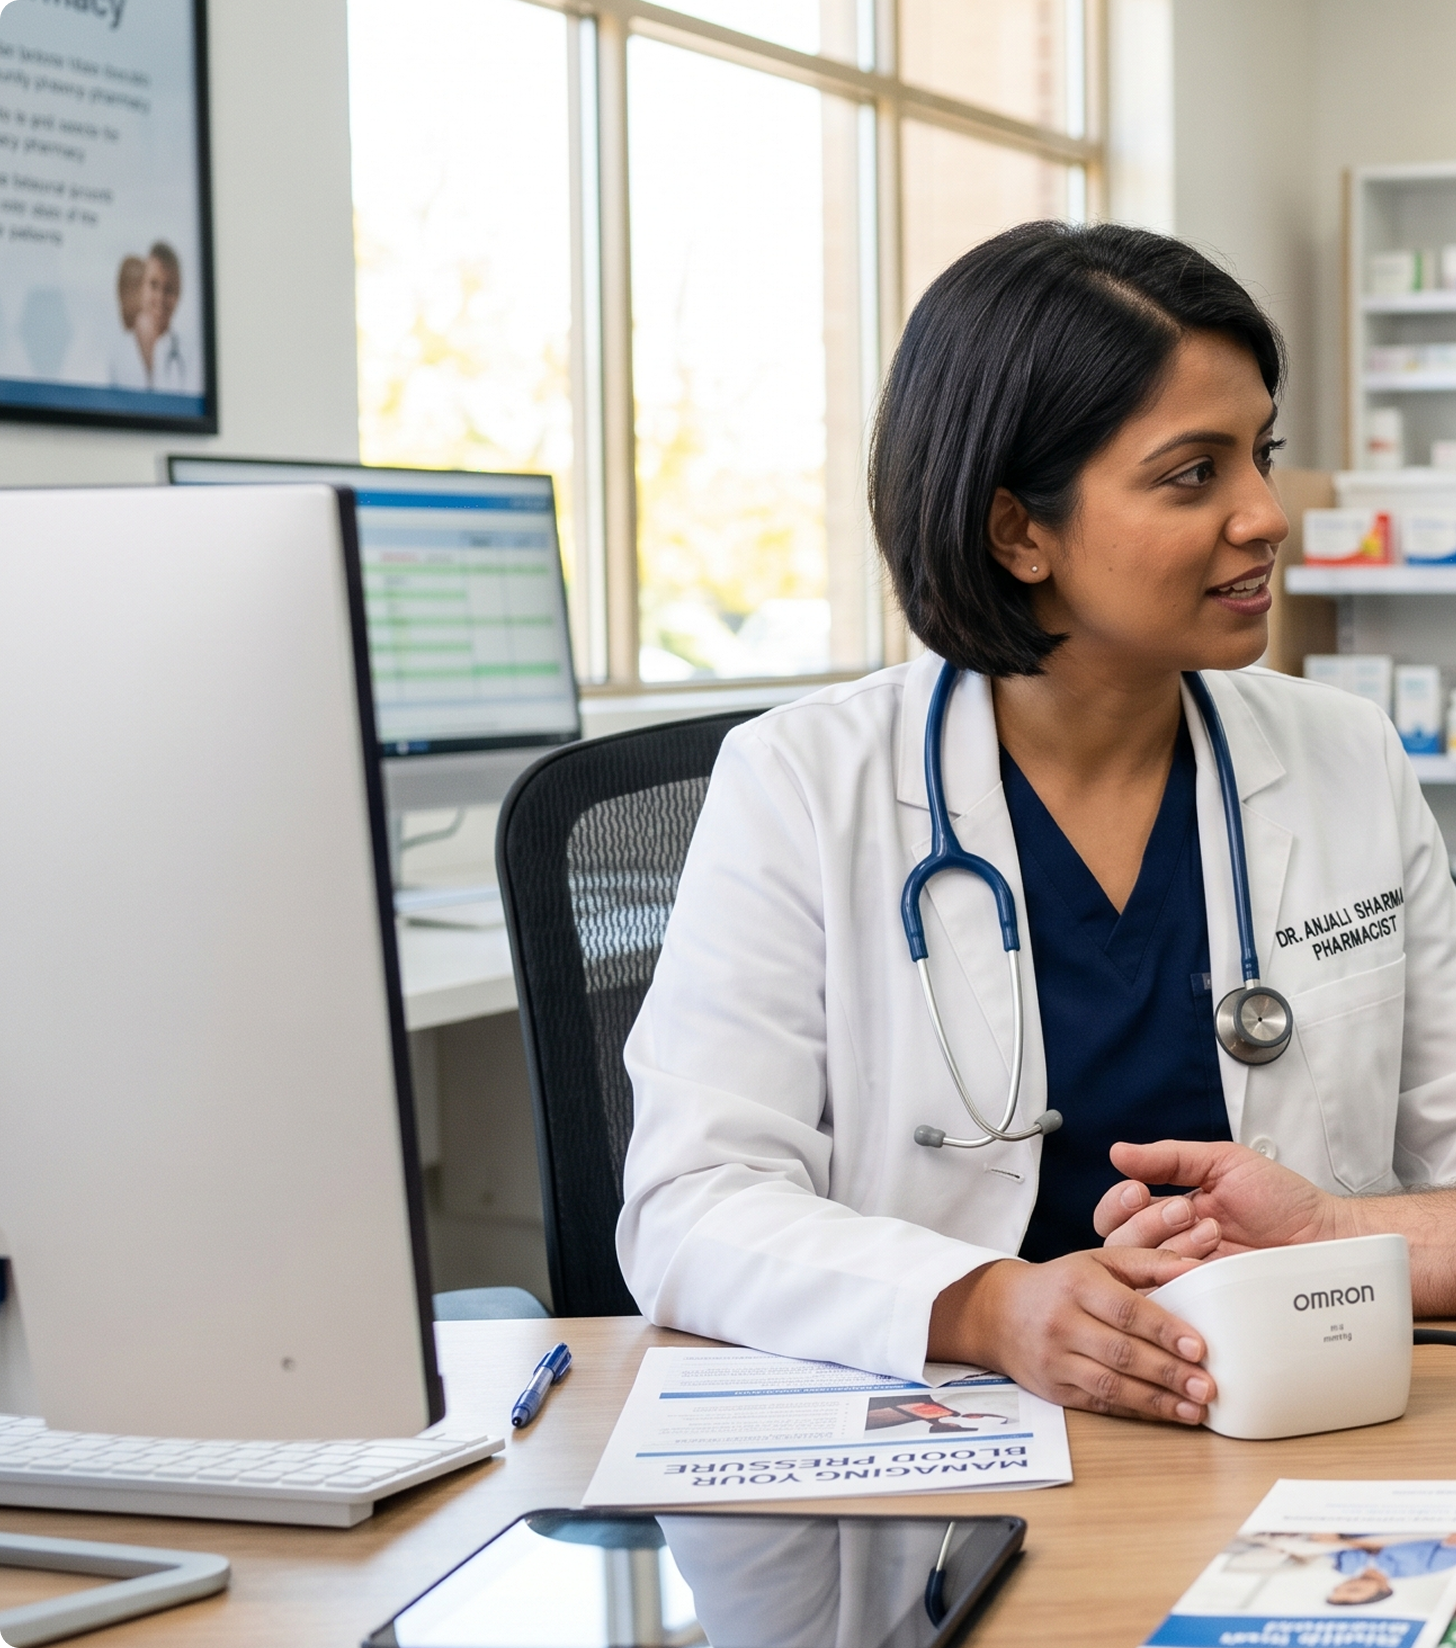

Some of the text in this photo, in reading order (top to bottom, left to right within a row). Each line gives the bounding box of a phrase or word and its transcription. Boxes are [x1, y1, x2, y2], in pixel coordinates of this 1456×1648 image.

[1275, 927, 1303, 948] DR.
[1304, 908, 1353, 939] ANJALI
[1312, 915, 1397, 961] PHARMACIST
[1293, 1285, 1375, 1312] OMRON
[664, 1445, 1027, 1475] BLOOD PRESSURE
[691, 1459, 1028, 1487] MANAGING YOUR
